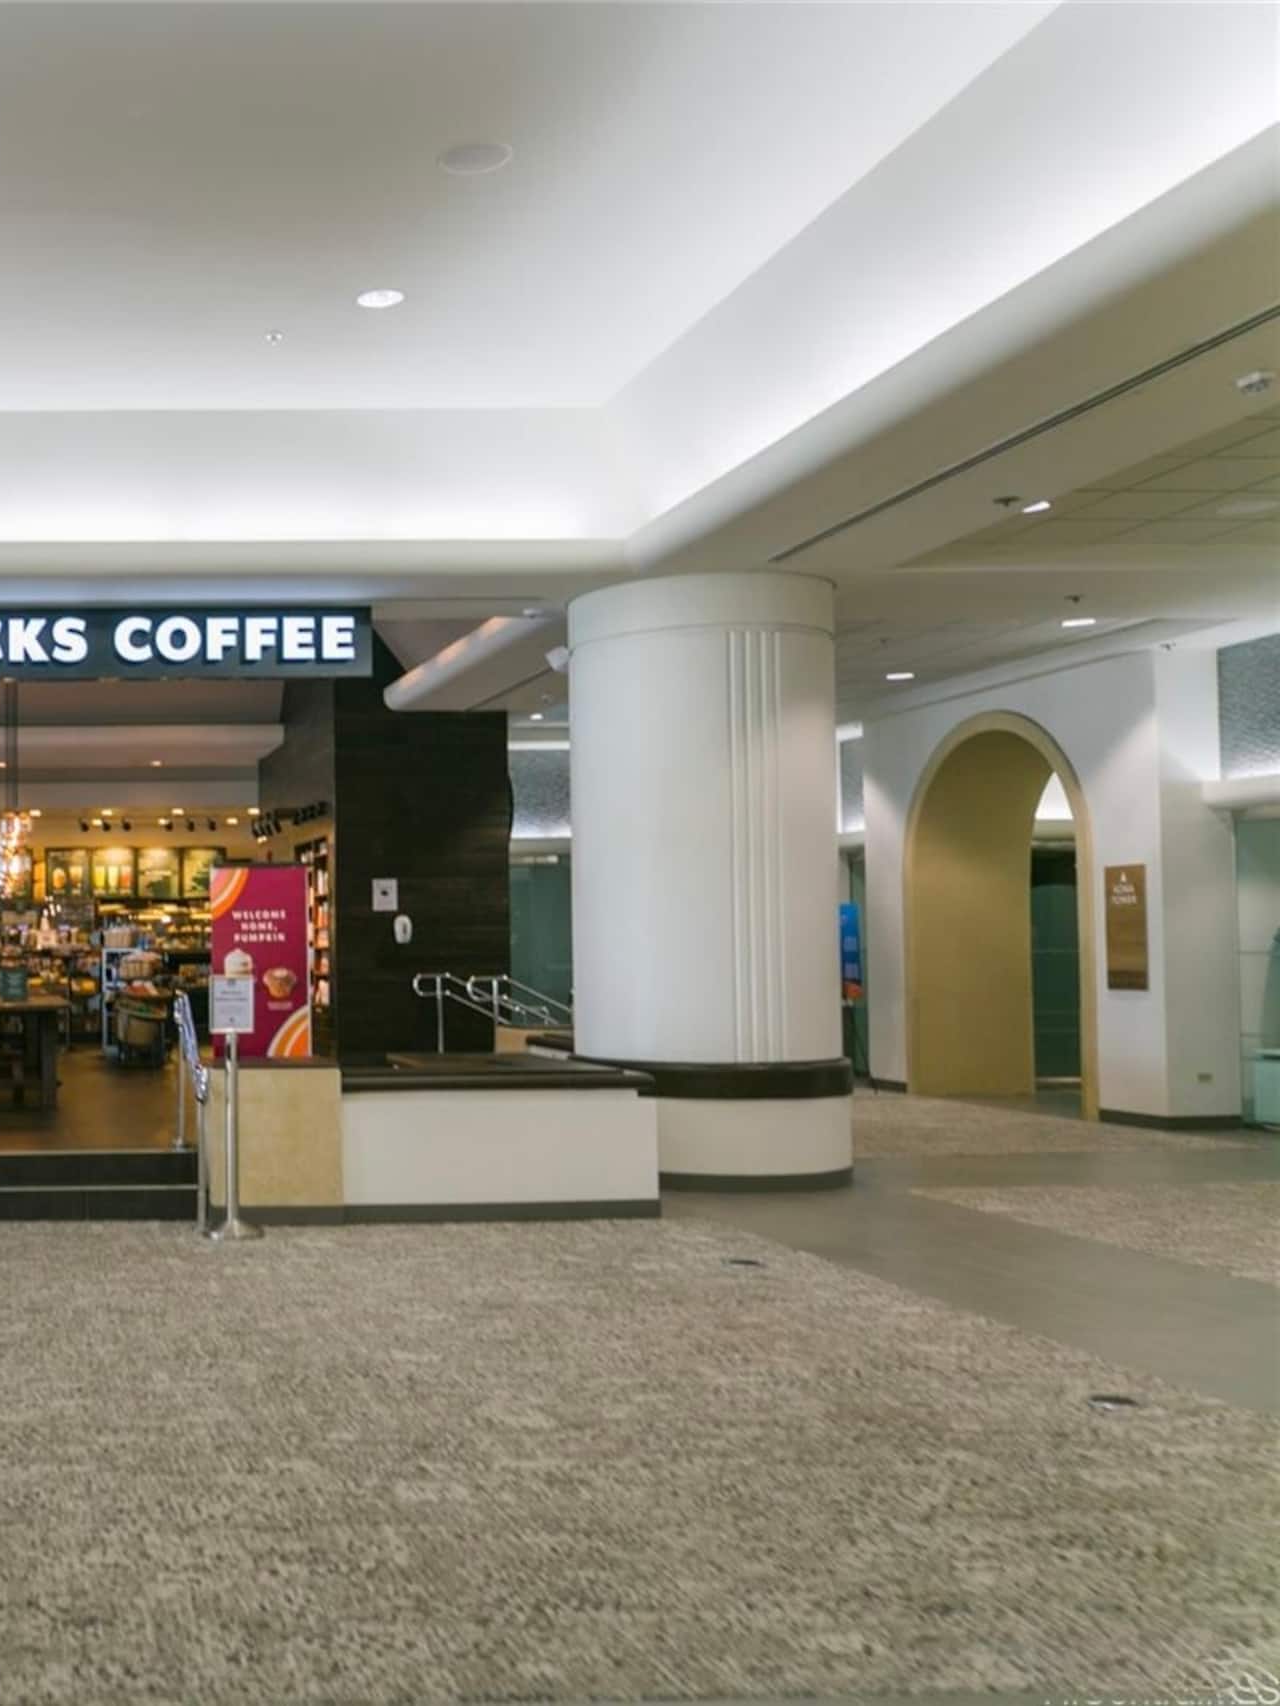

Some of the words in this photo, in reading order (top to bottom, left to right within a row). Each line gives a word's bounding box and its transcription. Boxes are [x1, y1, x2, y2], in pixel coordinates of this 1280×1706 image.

[113, 616, 356, 662] COFFEE
[231, 909, 287, 920] WELCOME
[233, 932, 286, 943] PUMPKIN
